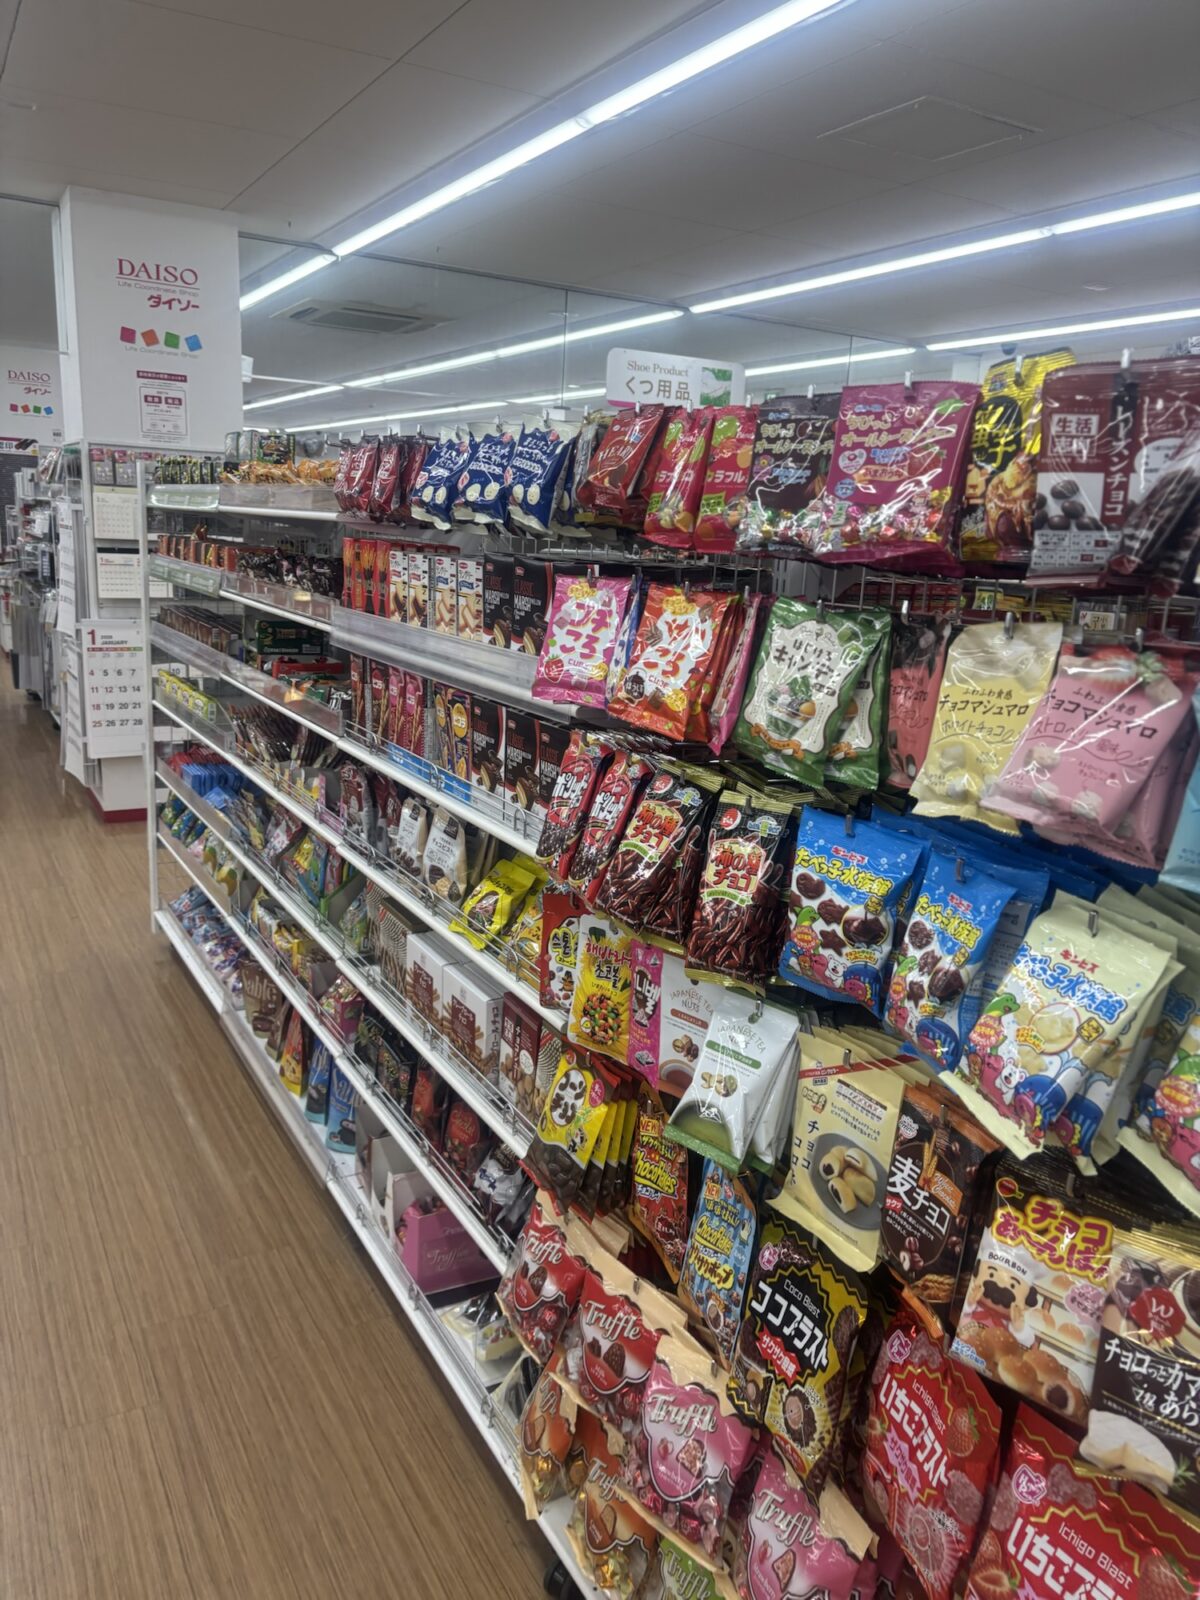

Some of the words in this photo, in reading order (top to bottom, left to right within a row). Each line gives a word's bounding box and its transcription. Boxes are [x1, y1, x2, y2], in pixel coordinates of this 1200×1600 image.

[117, 258, 198, 286] DAISO
[147, 294, 200, 312] ダイソー
[8, 370, 51, 382] DAISO
[626, 359, 651, 373] Shoe
[652, 363, 689, 378] Product
[625, 376, 691, 401] くつ用品
[87, 628, 96, 645] 1
[89, 669, 95, 677] 4
[103, 669, 109, 677] 5
[116, 668, 122, 677] 6
[130, 668, 136, 677] 7
[91, 686, 99, 694] 11
[105, 686, 114, 694] 12
[118, 685, 128, 693] 13
[132, 685, 141, 693] 14
[92, 703, 101, 711] 18
[105, 703, 115, 711] 19
[118, 702, 129, 711] 20
[132, 702, 142, 710] 21
[938, 693, 1030, 718] チョコマシュマロ
[92, 720, 103, 728] 25
[105, 719, 116, 728] 26
[119, 719, 130, 727] 27
[132, 719, 143, 727] 28
[795, 846, 894, 897] たべっ子水族館
[669, 987, 703, 1003] JAPANESE
[681, 999, 700, 1014] NUTS
[887, 1154, 951, 1236] 麦チョコ
[1030, 1199, 1110, 1249] チョコ
[988, 1251, 1029, 1277] BOURBON
[783, 1279, 803, 1300] Coco
[802, 1294, 821, 1319] Blast
[583, 1299, 643, 1342] Truffle
[750, 1280, 830, 1371] ココブラスト
[912, 1378, 934, 1410] Ichigo
[648, 1392, 718, 1435] Truffle
[1158, 1391, 1200, 1427] あら
[878, 1372, 951, 1489] いちごブラスト
[755, 1488, 818, 1548] Truffle
[1059, 1521, 1096, 1559] Ichigo
[1096, 1551, 1133, 1590] Blast
